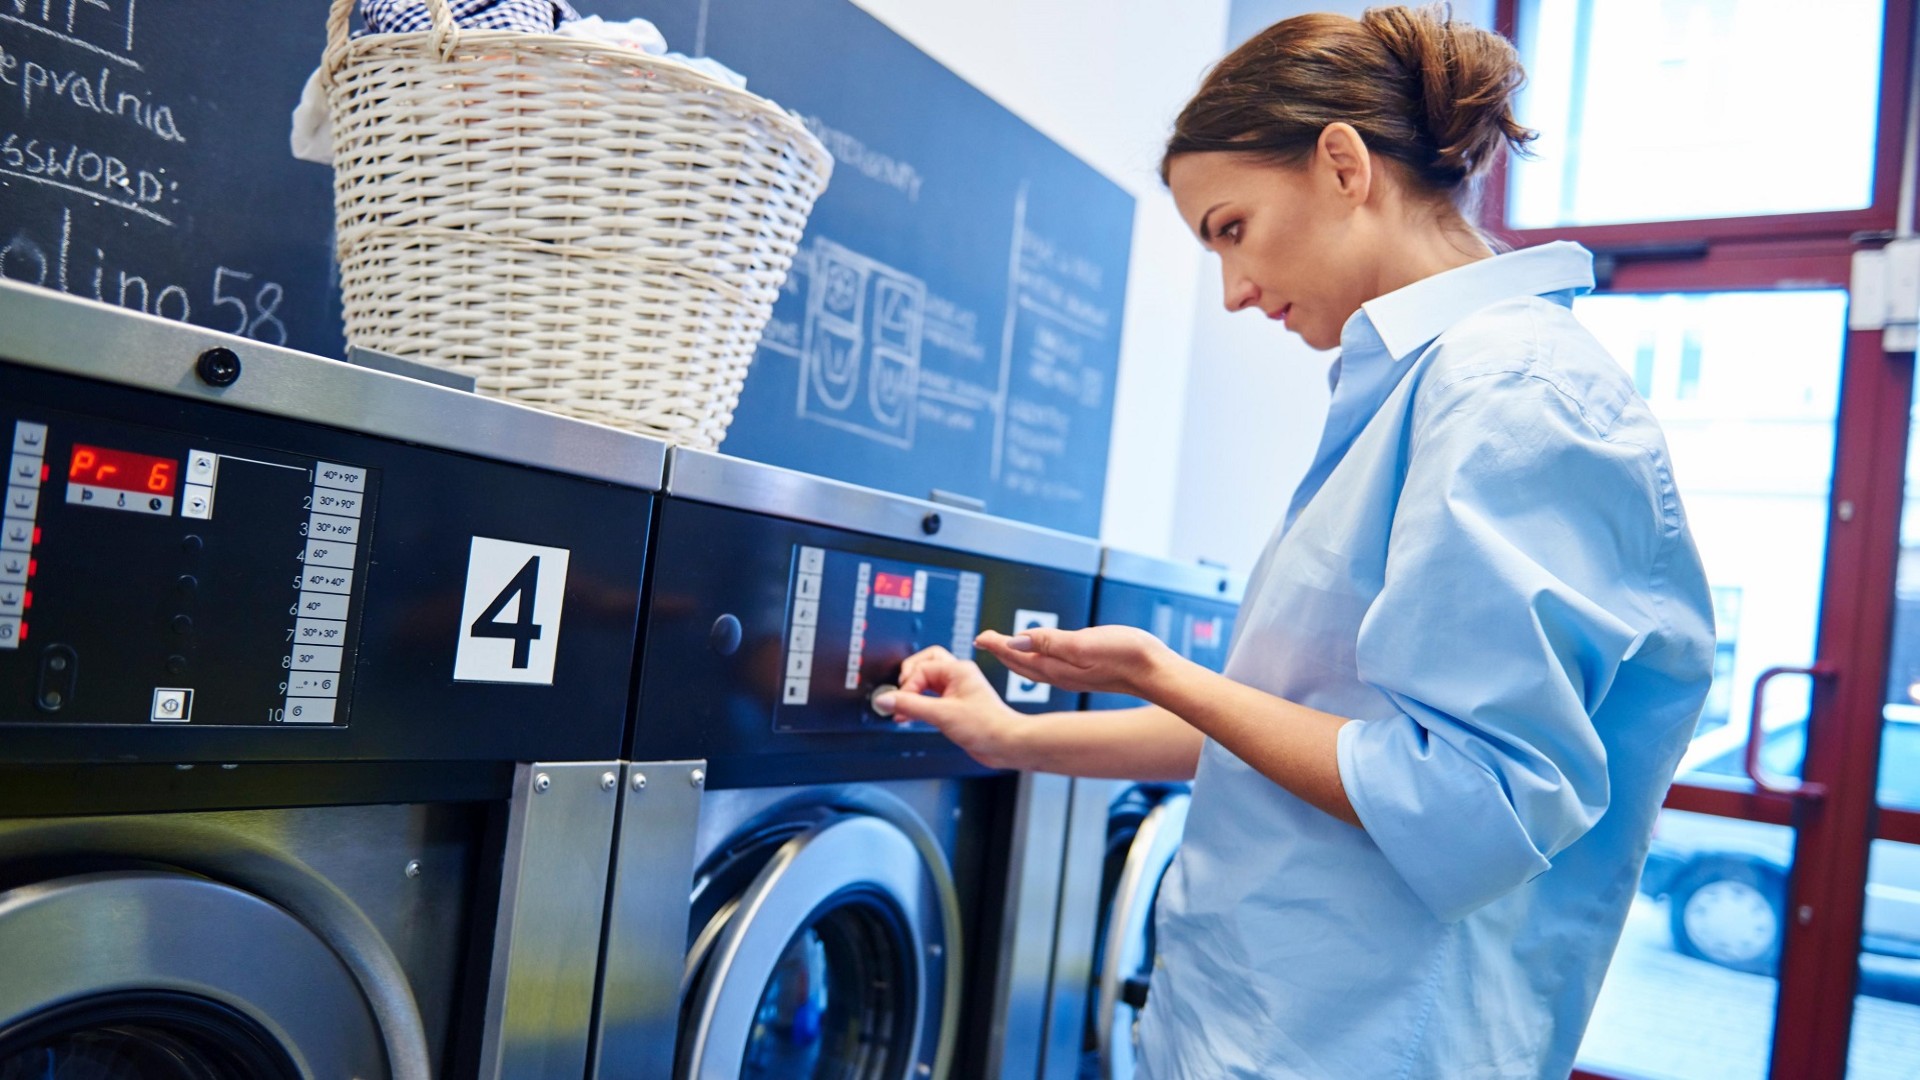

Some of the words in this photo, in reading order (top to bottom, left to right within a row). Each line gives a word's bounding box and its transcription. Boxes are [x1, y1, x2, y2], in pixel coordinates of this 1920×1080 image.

[69, 450, 117, 481] Pr
[147, 462, 170, 491] 6
[303, 495, 312, 510] 2
[299, 522, 309, 536] 3
[296, 549, 305, 562] 4
[292, 575, 302, 589] 5
[289, 602, 298, 616] 6
[470, 555, 542, 669] 4
[285, 628, 295, 642] 7
[281, 655, 291, 669] 8
[278, 681, 288, 695] 9
[268, 708, 284, 722] 10
